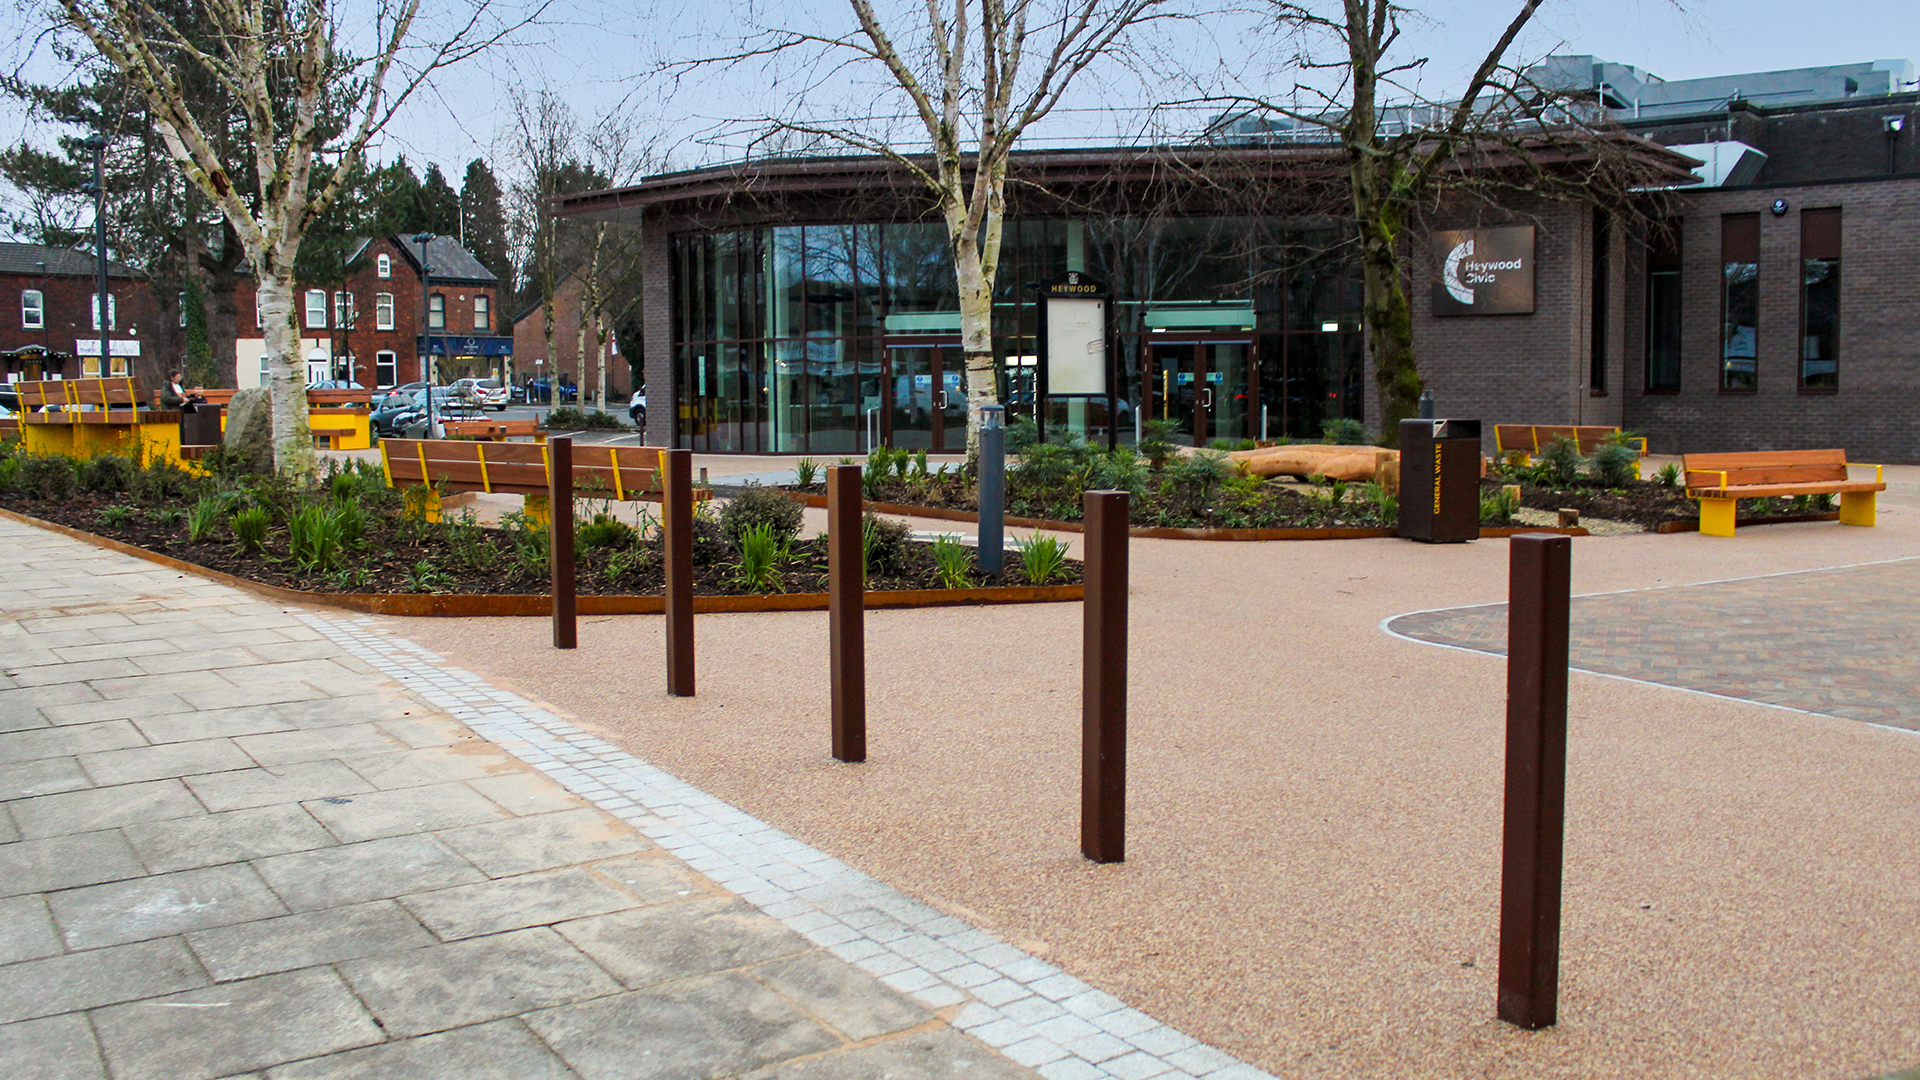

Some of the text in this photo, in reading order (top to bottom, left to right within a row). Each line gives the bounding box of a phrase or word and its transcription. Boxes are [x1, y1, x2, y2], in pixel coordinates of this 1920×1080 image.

[1465, 258, 1521, 273] Heywood
[1465, 272, 1496, 284] Civic
[1051, 285, 1097, 293] HEYWOOD
